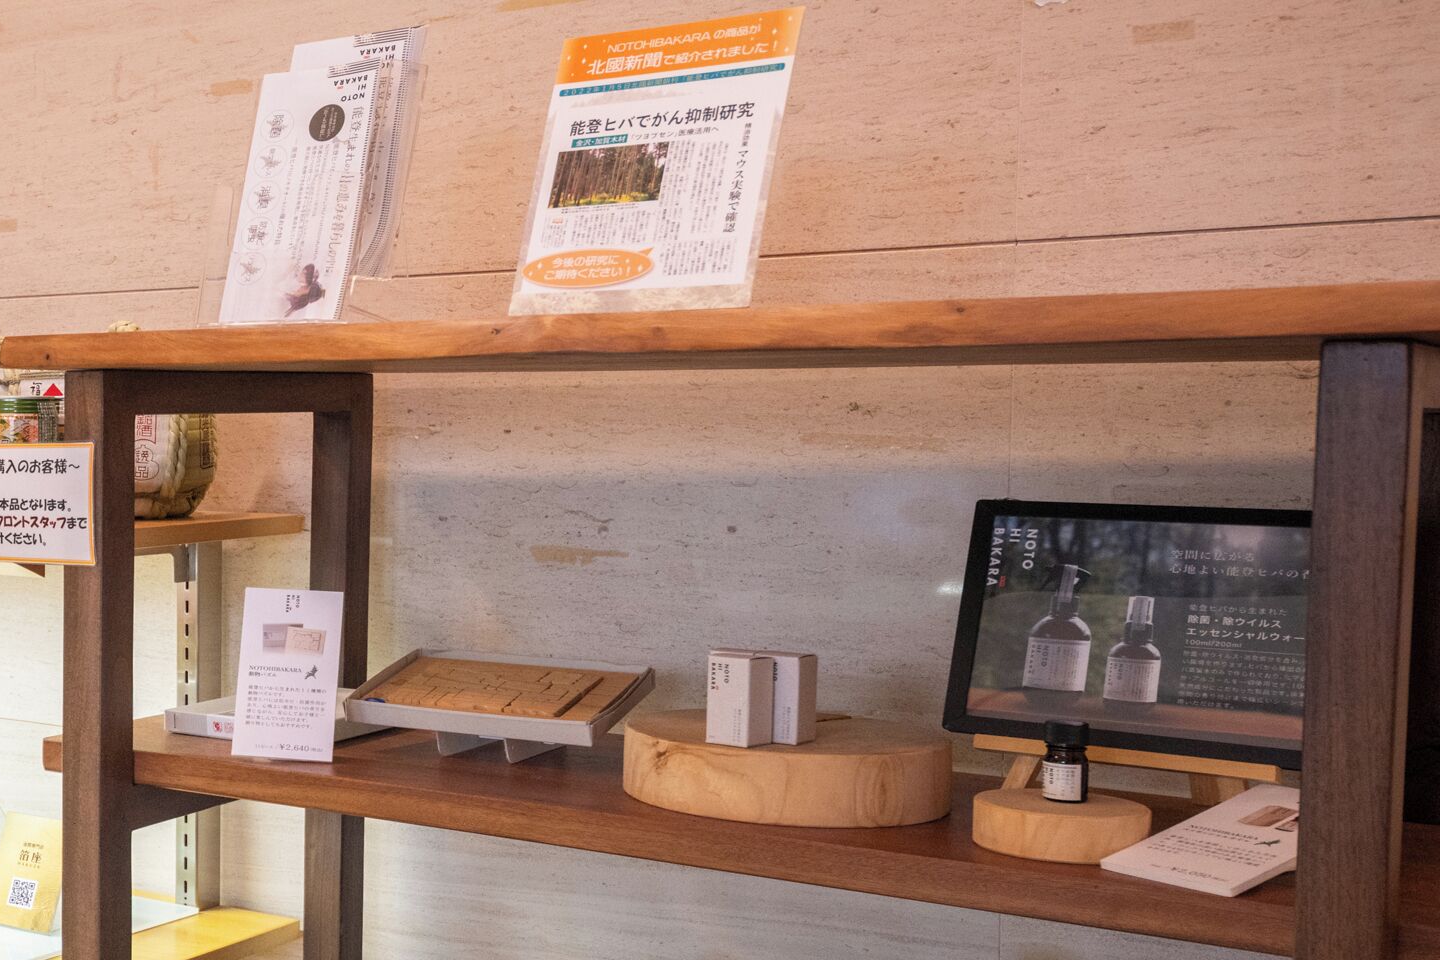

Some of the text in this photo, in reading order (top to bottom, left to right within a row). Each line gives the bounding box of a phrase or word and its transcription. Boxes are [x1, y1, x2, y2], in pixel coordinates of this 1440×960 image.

[607, 24, 761, 54] NOTOHIBAKARA の商品が
[360, 44, 396, 56] BAKARA
[333, 75, 368, 87] BAKARA
[340, 92, 365, 102] NOTO
[569, 102, 755, 137] 能登ヒバでがん抑制研究
[723, 150, 749, 233] マウス実験で確認
[552, 255, 620, 269] 今後の研究に
[1009, 528, 1021, 543] HI
[1022, 528, 1039, 570] NOTO
[1171, 550, 1255, 561] 空間に広がる
[986, 527, 1006, 586] BAKARA
[1187, 615, 1282, 629] 除菌・除ウイルス
